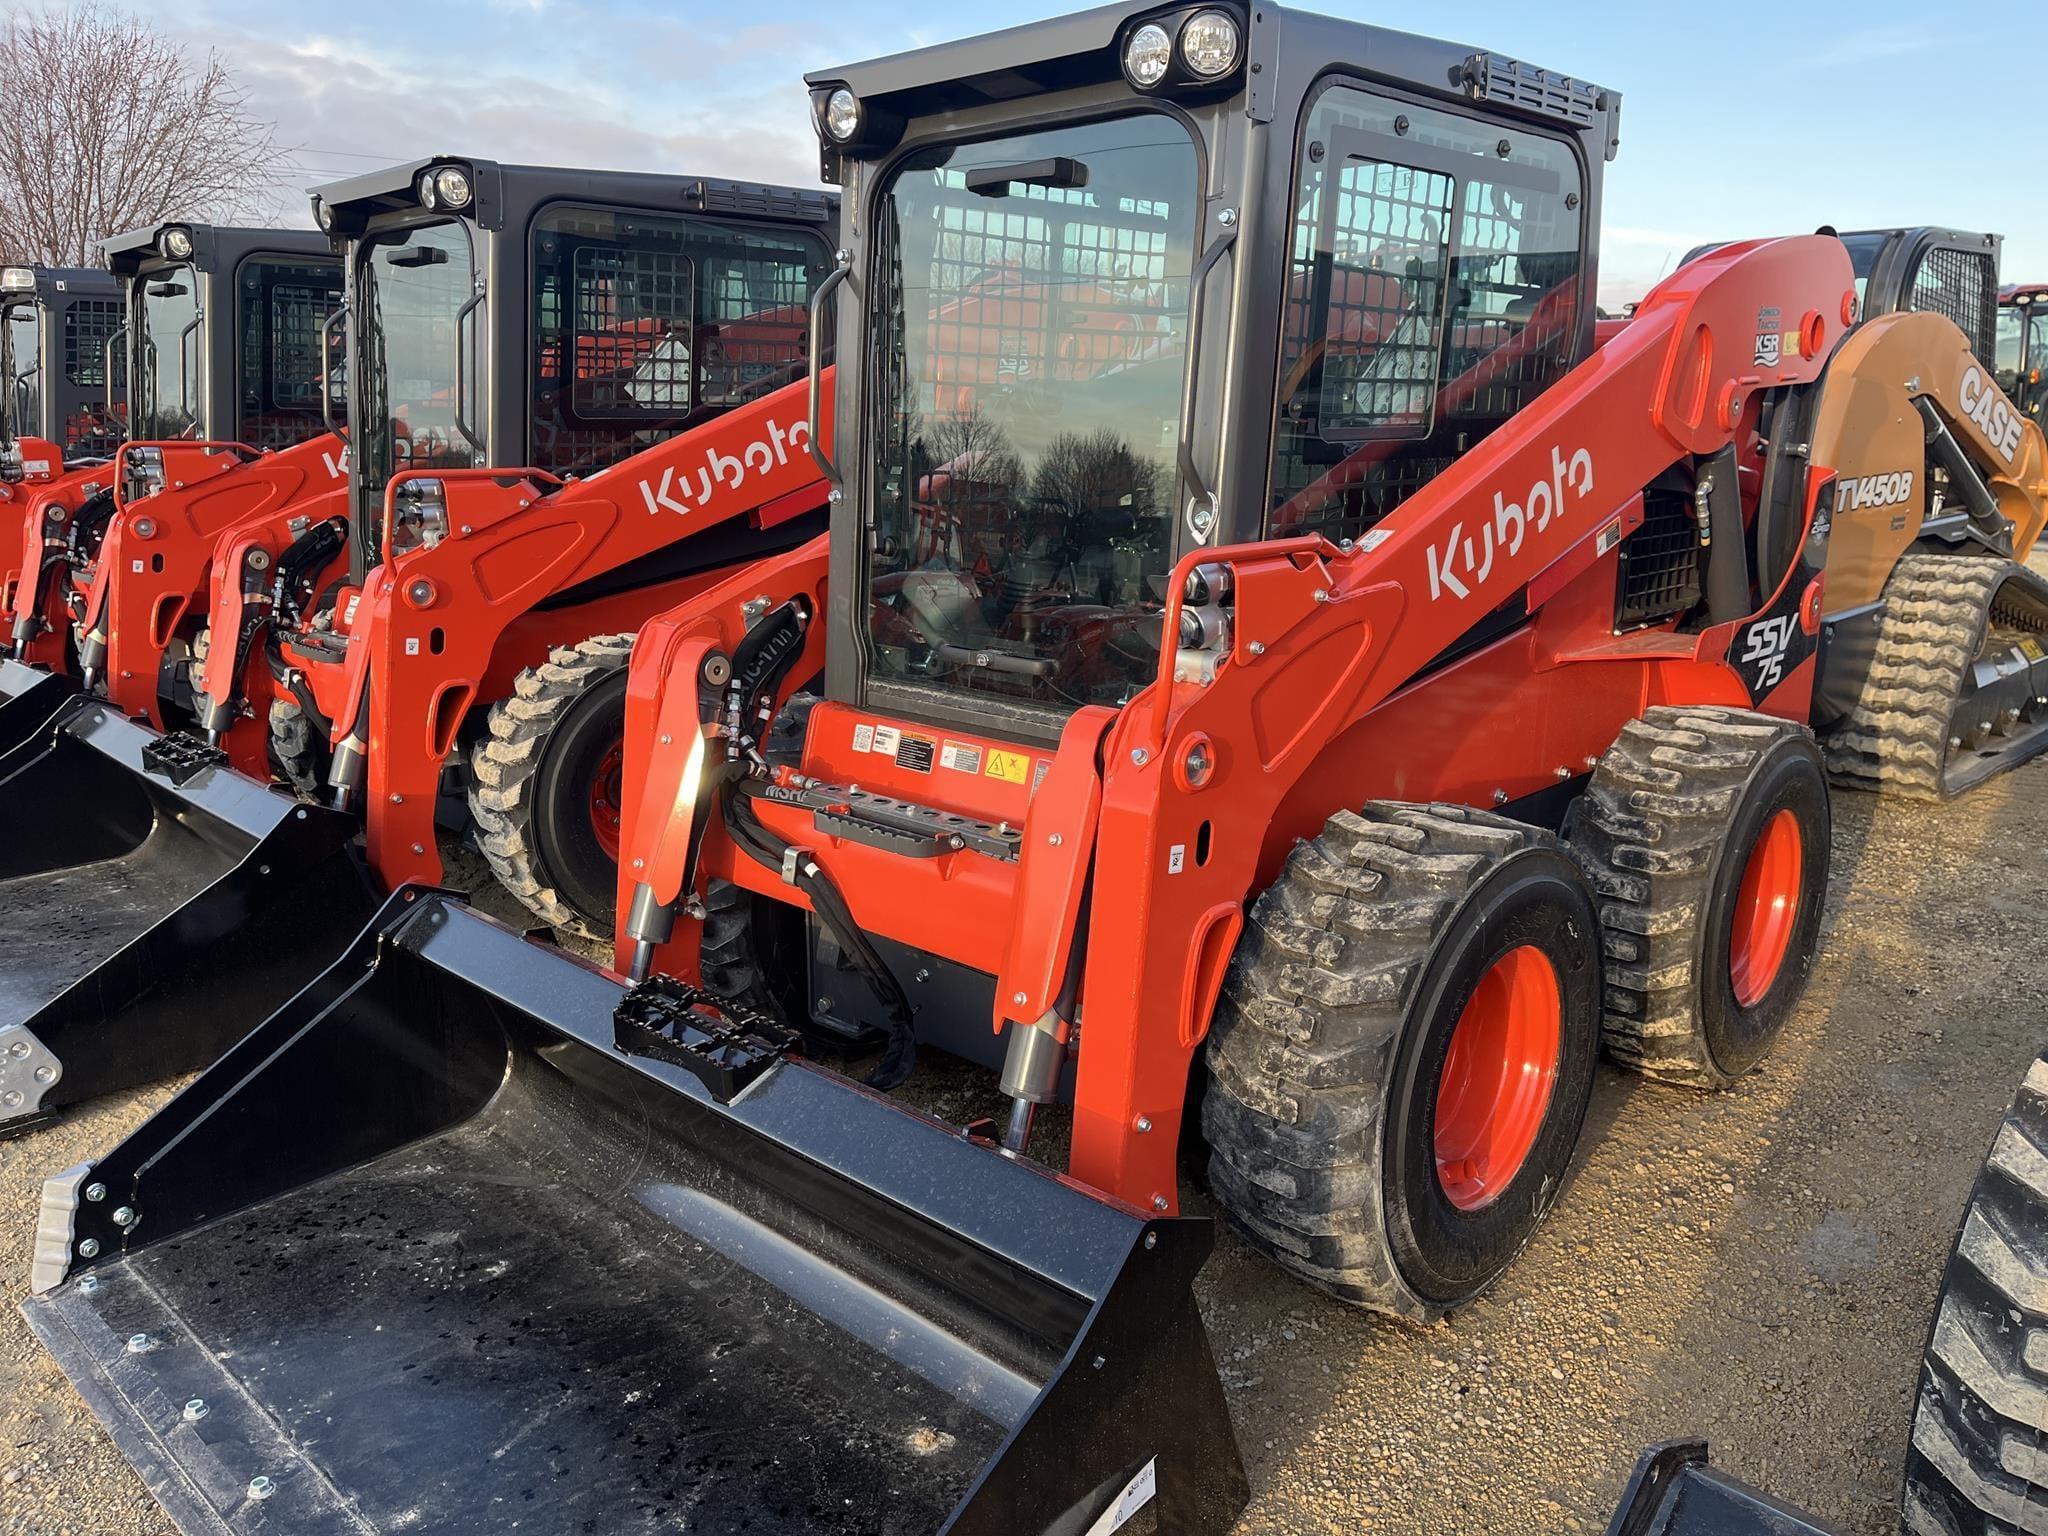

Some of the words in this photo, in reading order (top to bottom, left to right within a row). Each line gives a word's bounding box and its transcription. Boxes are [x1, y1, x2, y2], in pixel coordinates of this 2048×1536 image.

[1959, 365, 2023, 464] CASE
[1836, 470, 1914, 514] TV450B
[1426, 445, 1593, 601] Kubota
[1741, 612, 1799, 663] SSV
[1754, 653, 1785, 691] 75
